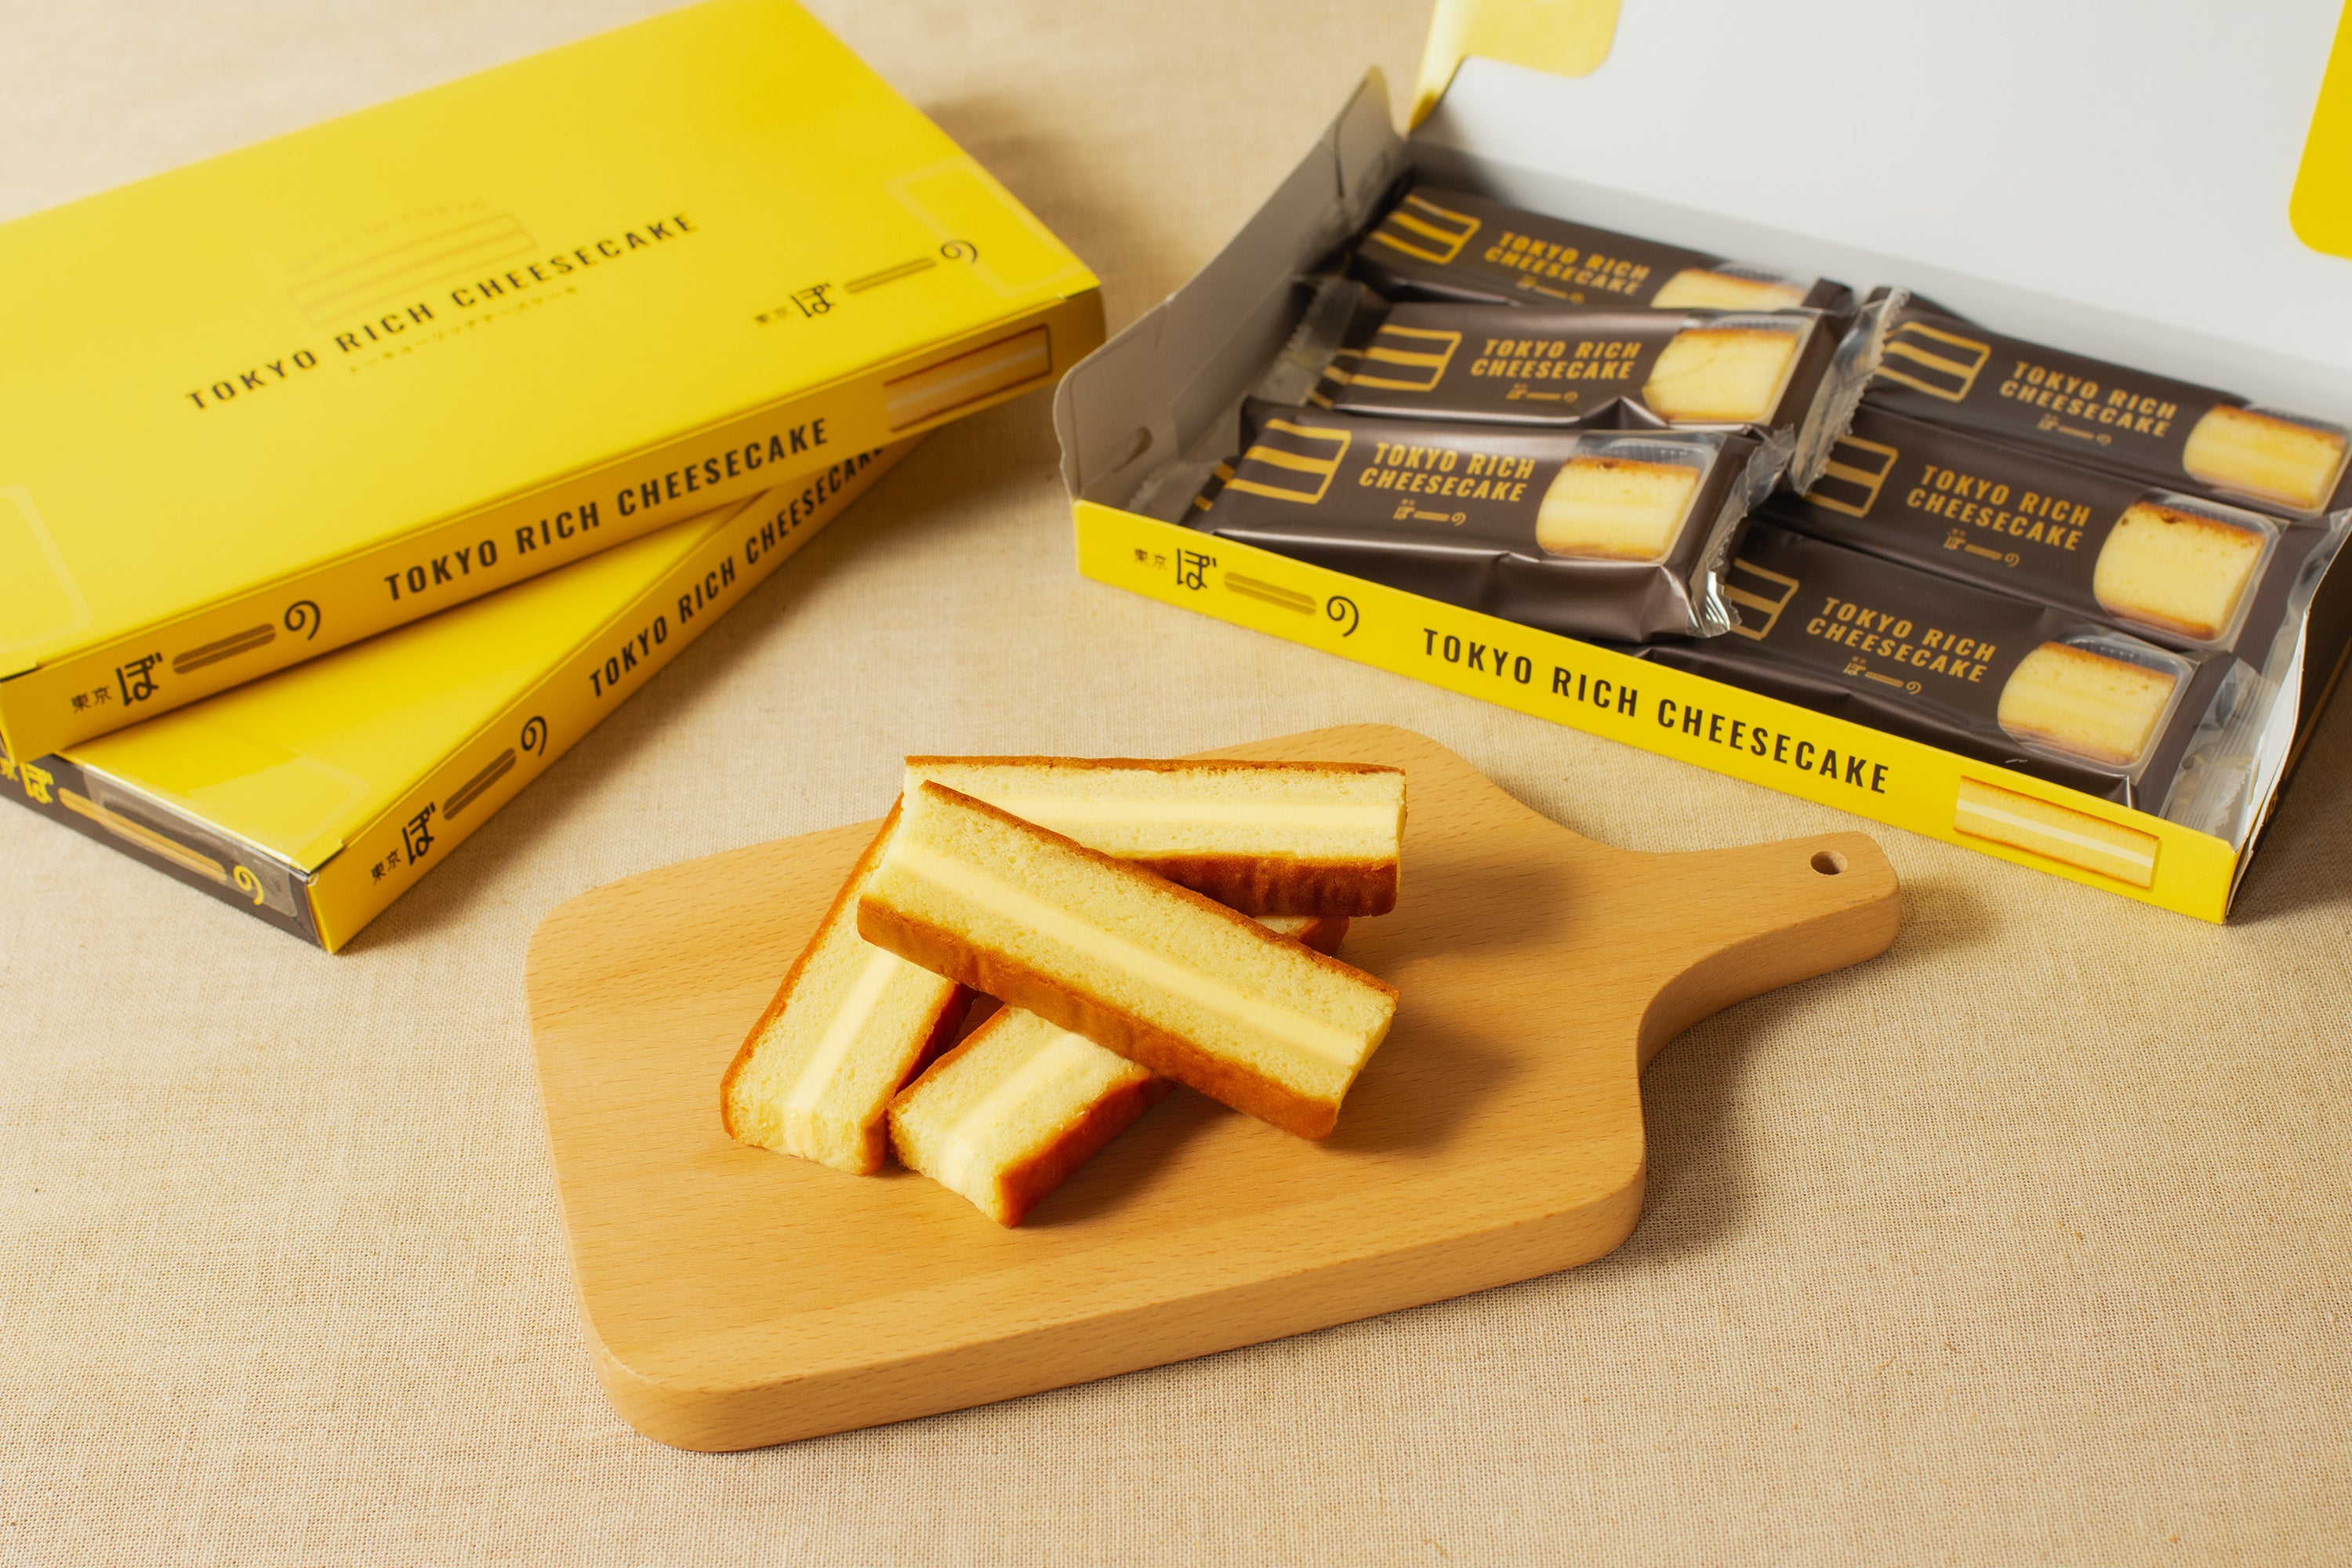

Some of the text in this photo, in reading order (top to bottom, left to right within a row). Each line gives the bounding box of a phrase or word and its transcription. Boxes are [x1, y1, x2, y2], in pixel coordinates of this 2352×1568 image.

[1484, 246, 1641, 296] CHEESECAKE
[1499, 231, 1650, 281] TOKYO RICH
[185, 212, 699, 410] TOKYO RICH CHEESECAKE
[1470, 358, 1635, 379] CHEESECAKE
[1483, 339, 1642, 359] TOKYO RICH
[2000, 379, 2171, 437] CHEESECAKE
[2013, 360, 2177, 420] TOKYO RICH
[1359, 467, 1527, 502] CHEESECAKE
[1374, 442, 1536, 480] TOKYO RICH
[384, 417, 828, 601] TOKYO RICH CHEESECAKE
[1907, 488, 2083, 550] CHEESECAKE
[1922, 464, 2091, 527] TOKYO RICH
[589, 615, 667, 698] TOKYO
[677, 556, 736, 624] RICH
[1806, 618, 1987, 682] CHEESECAKE
[1822, 597, 1996, 662] TOKYO RICH
[71, 686, 111, 713] 東京
[1423, 628, 1889, 794] TOKYO RICH CHEESECAKE
[371, 848, 401, 885] 東京
